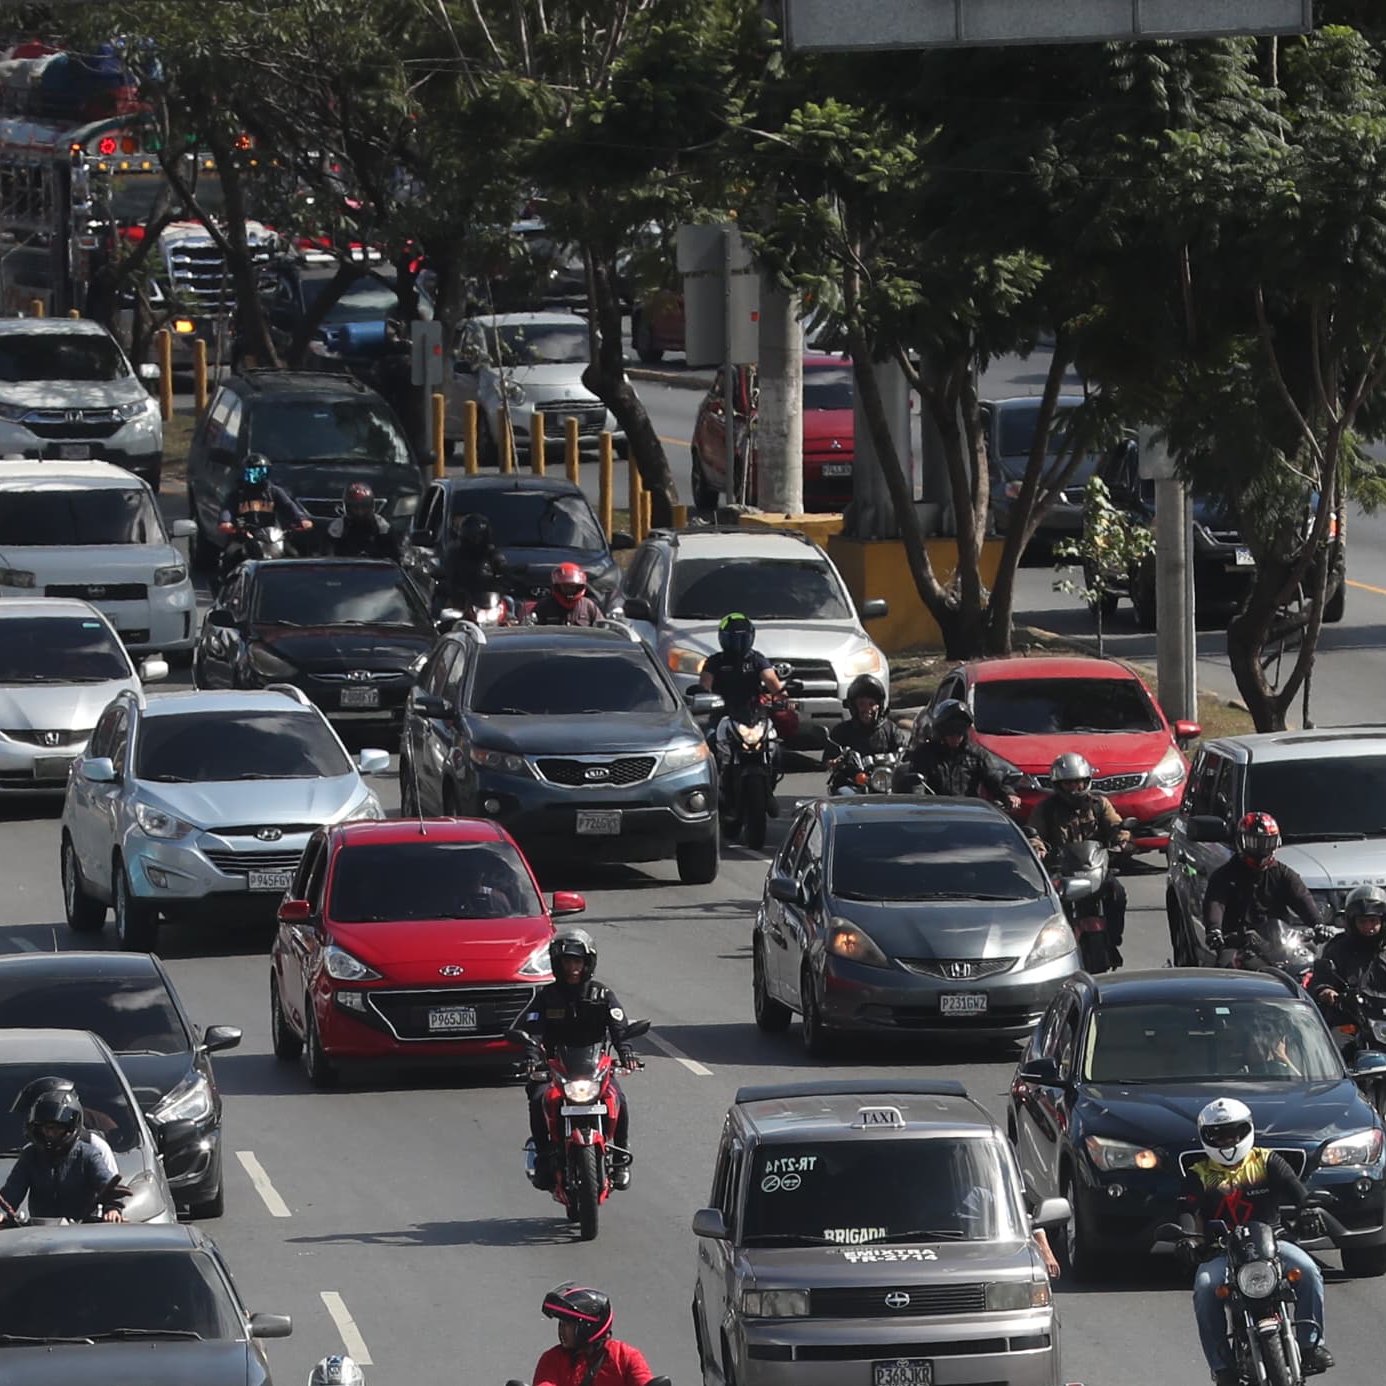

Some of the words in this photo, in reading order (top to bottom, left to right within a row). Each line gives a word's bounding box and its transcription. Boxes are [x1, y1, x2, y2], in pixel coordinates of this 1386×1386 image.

[942, 996, 986, 1011] P231GWZ
[430, 1012, 476, 1027] P965JRN
[860, 1111, 894, 1124] TAXI
[876, 1367, 932, 1386] P368JKR
